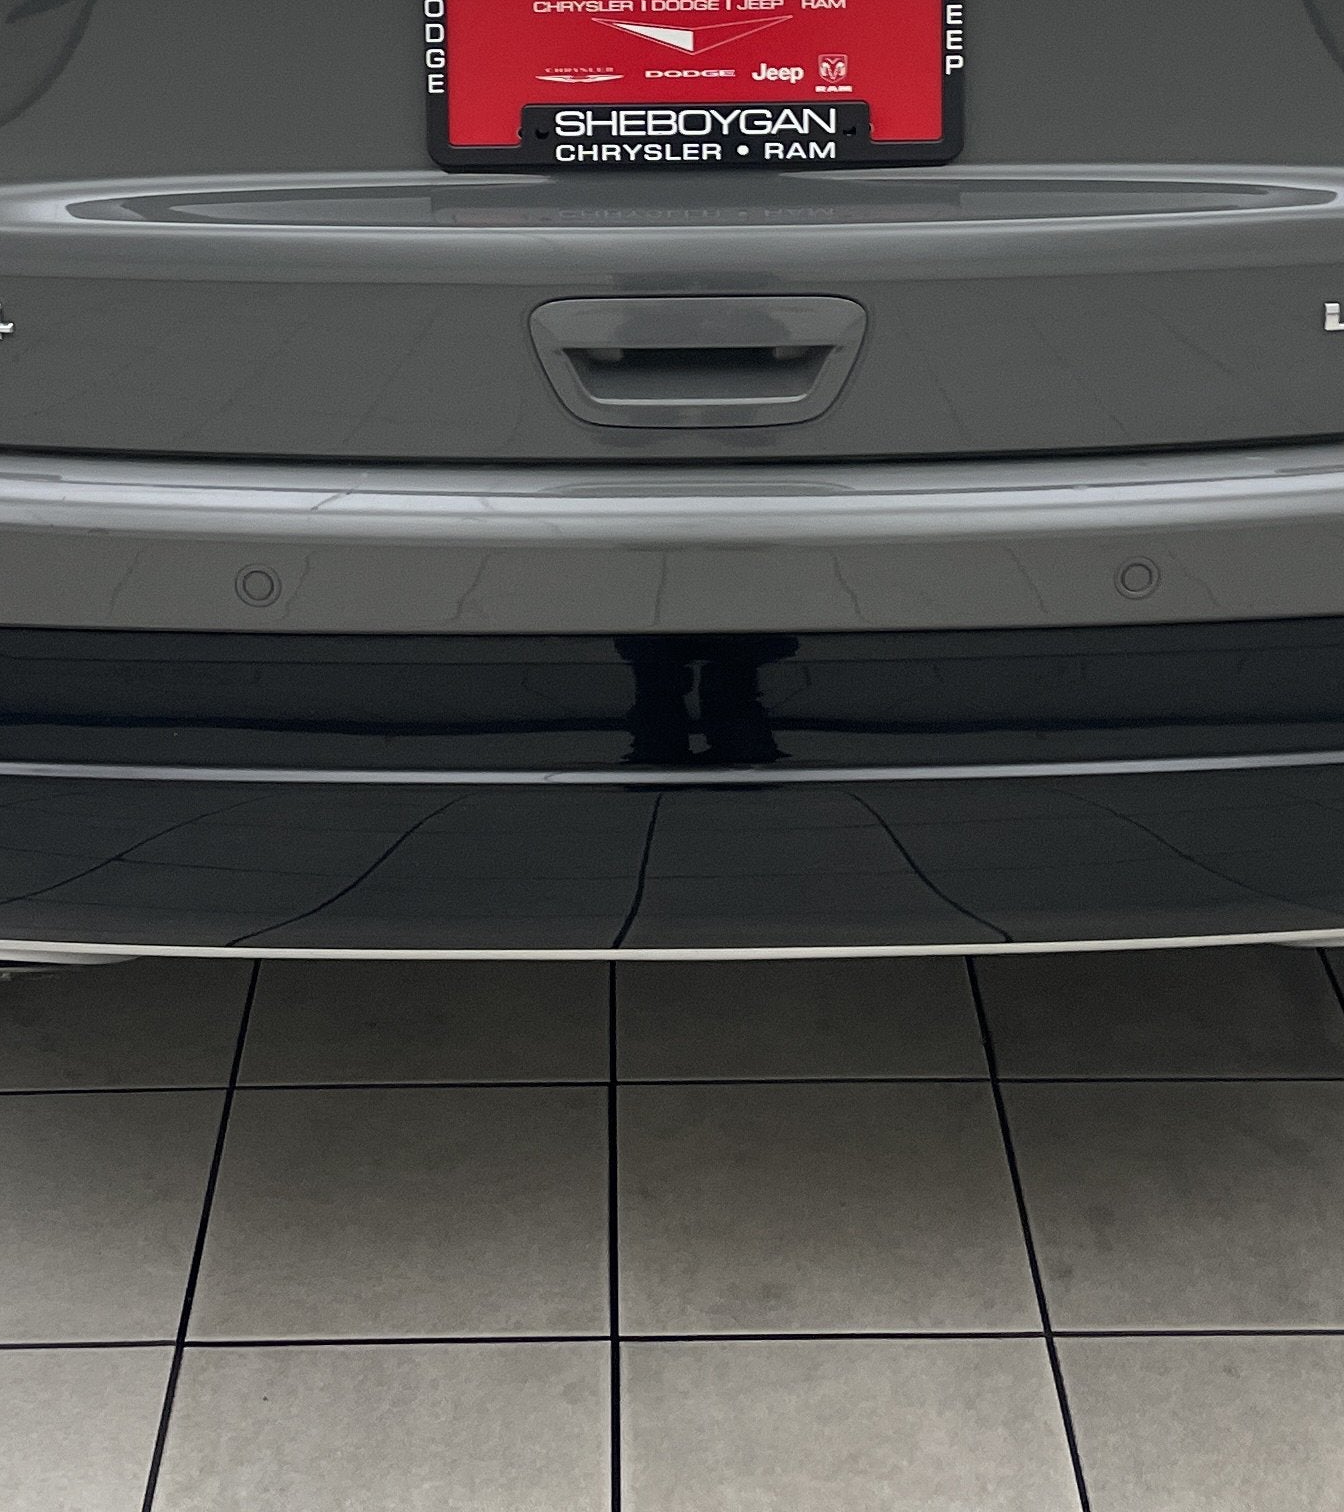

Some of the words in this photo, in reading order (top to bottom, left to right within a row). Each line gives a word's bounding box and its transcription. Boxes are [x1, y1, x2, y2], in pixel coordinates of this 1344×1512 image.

[533, 0, 634, 13] CHRYSLER
[651, 0, 720, 11] DODGE
[644, 69, 736, 78] DODGE
[751, 63, 804, 84] Jeep
[555, 108, 837, 136] SHEBOYGAN
[555, 142, 722, 161] CHRYSLER
[764, 141, 837, 159] RAM
